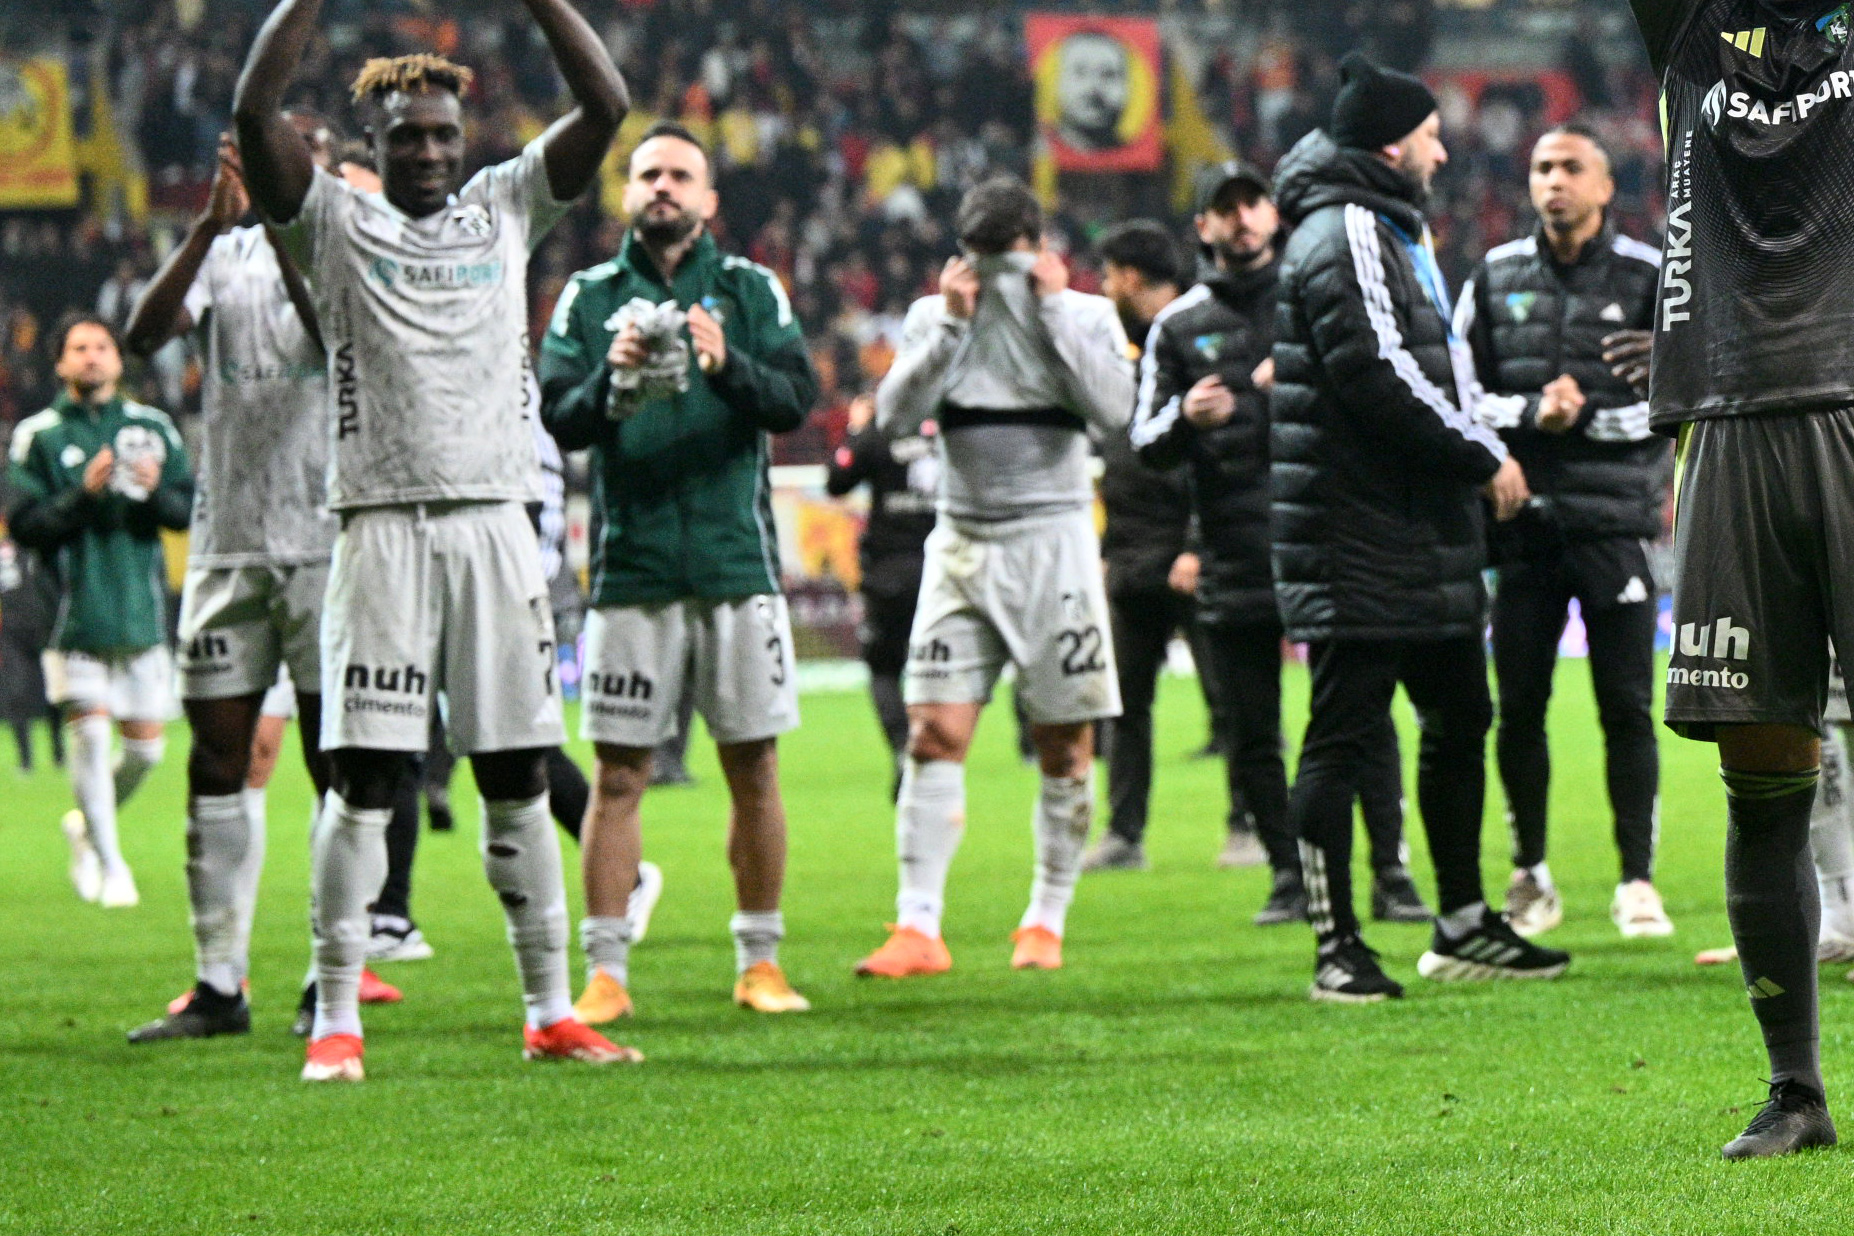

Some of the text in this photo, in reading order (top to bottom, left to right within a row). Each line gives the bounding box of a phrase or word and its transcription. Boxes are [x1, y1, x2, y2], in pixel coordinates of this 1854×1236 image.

[1683, 130, 1693, 198] MUAYENE
[1662, 200, 1692, 331] TURKA
[1055, 623, 1107, 677] 22
[344, 663, 426, 696] nuh
[1667, 666, 1750, 690] mento
